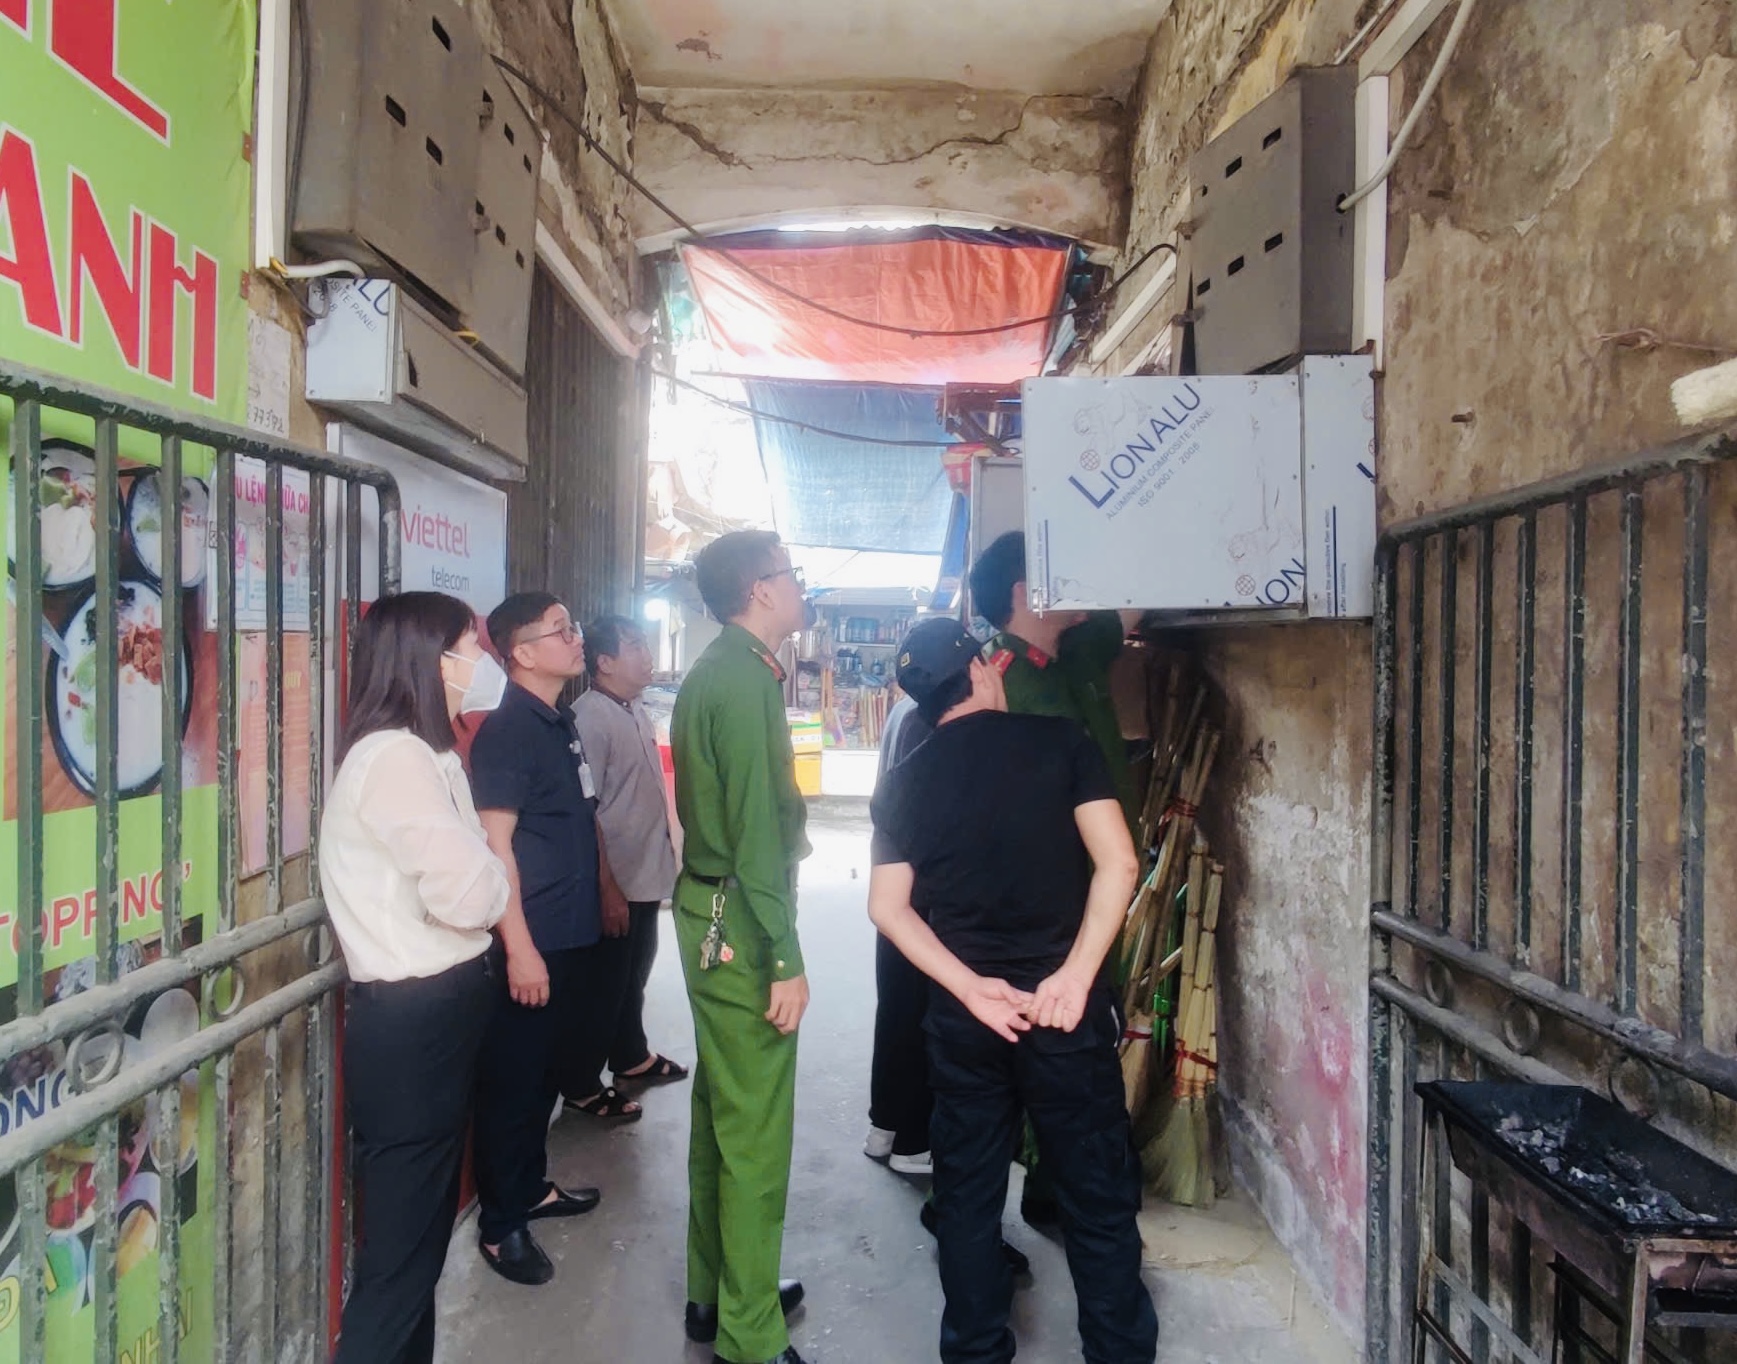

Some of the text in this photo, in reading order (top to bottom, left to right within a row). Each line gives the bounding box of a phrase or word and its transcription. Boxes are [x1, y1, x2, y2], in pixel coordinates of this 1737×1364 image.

[1068, 383, 1201, 509] LIONALU
[1106, 475, 1150, 520] ALUMINIUM
[1146, 429, 1193, 477] COMPOSITE
[1137, 490, 1155, 507] ISO
[1153, 468, 1175, 490] 9001
[432, 565, 470, 592] telecom
